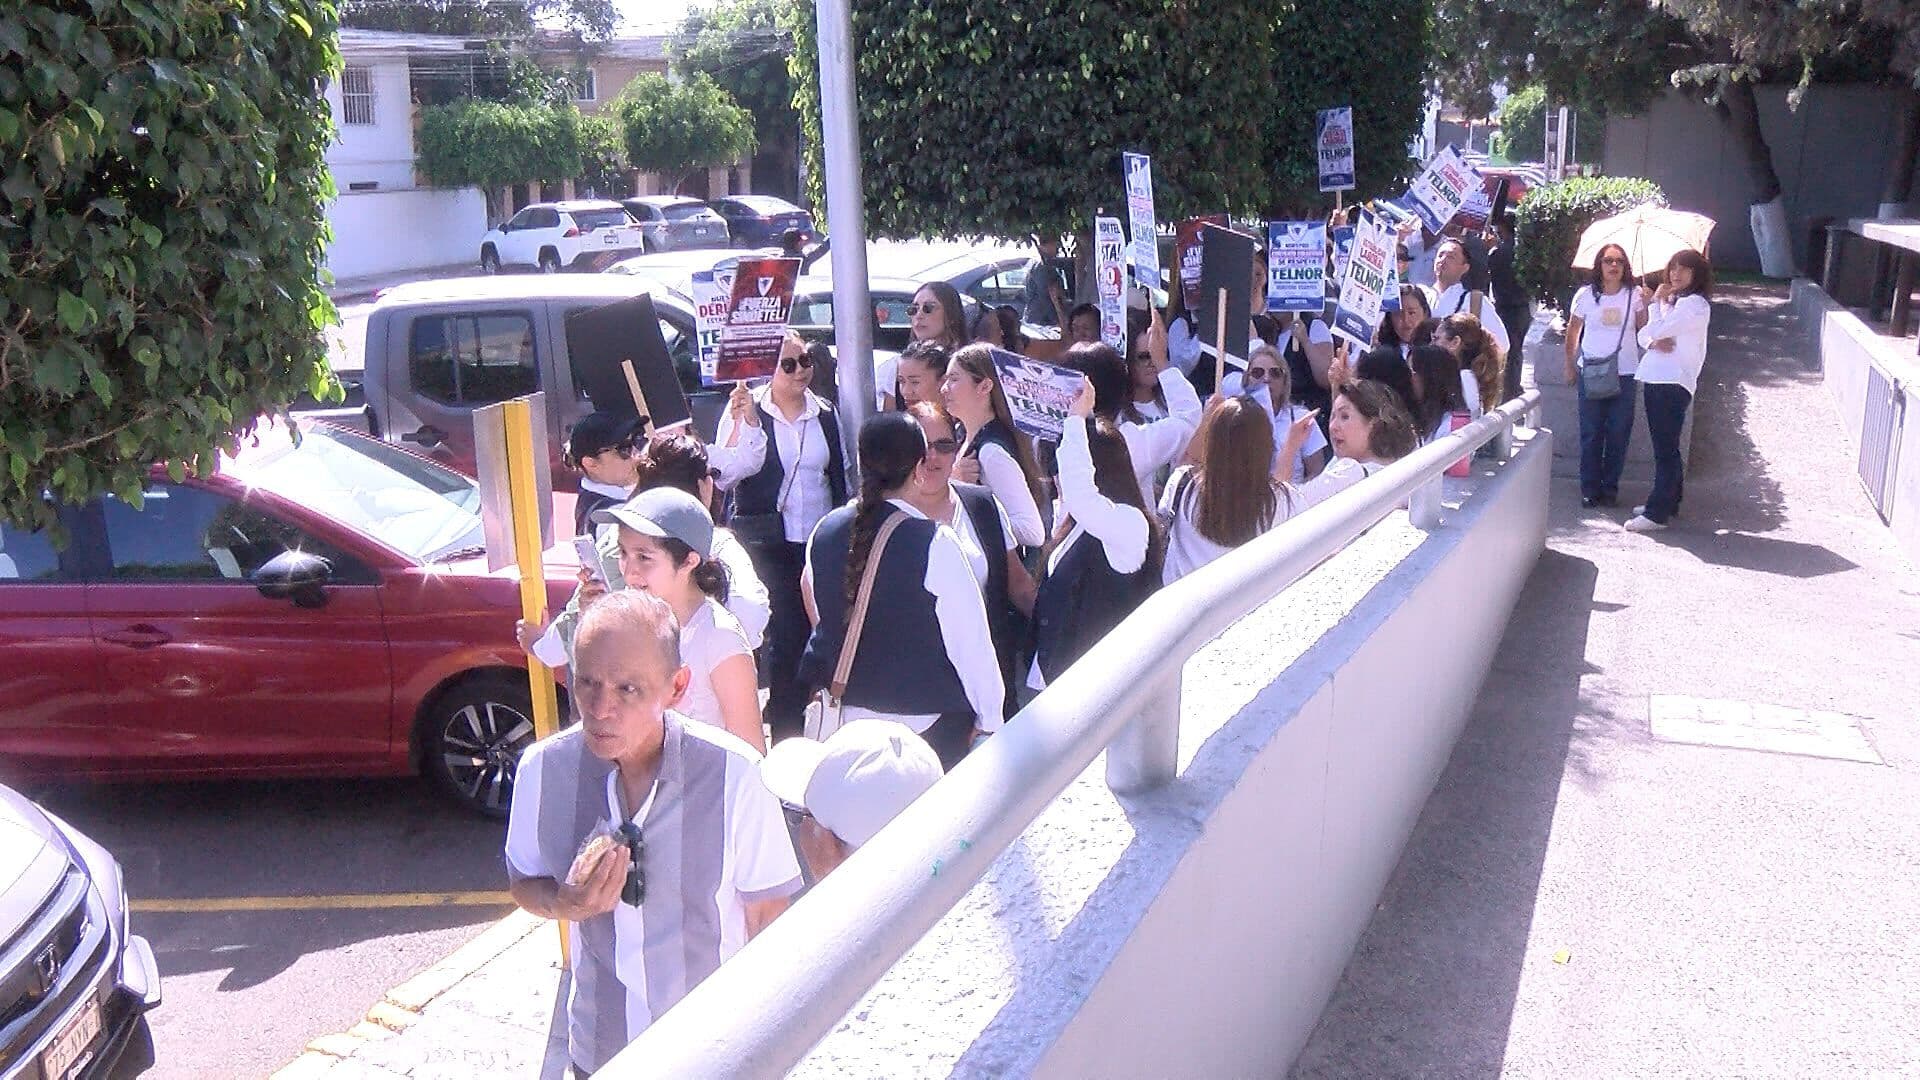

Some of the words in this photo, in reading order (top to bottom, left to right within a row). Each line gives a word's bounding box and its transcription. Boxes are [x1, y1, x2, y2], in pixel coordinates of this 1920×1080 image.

[1428, 170, 1461, 208] TELNOR
[1271, 267, 1323, 280] TELNOR
[1350, 260, 1384, 296] TELNOR
